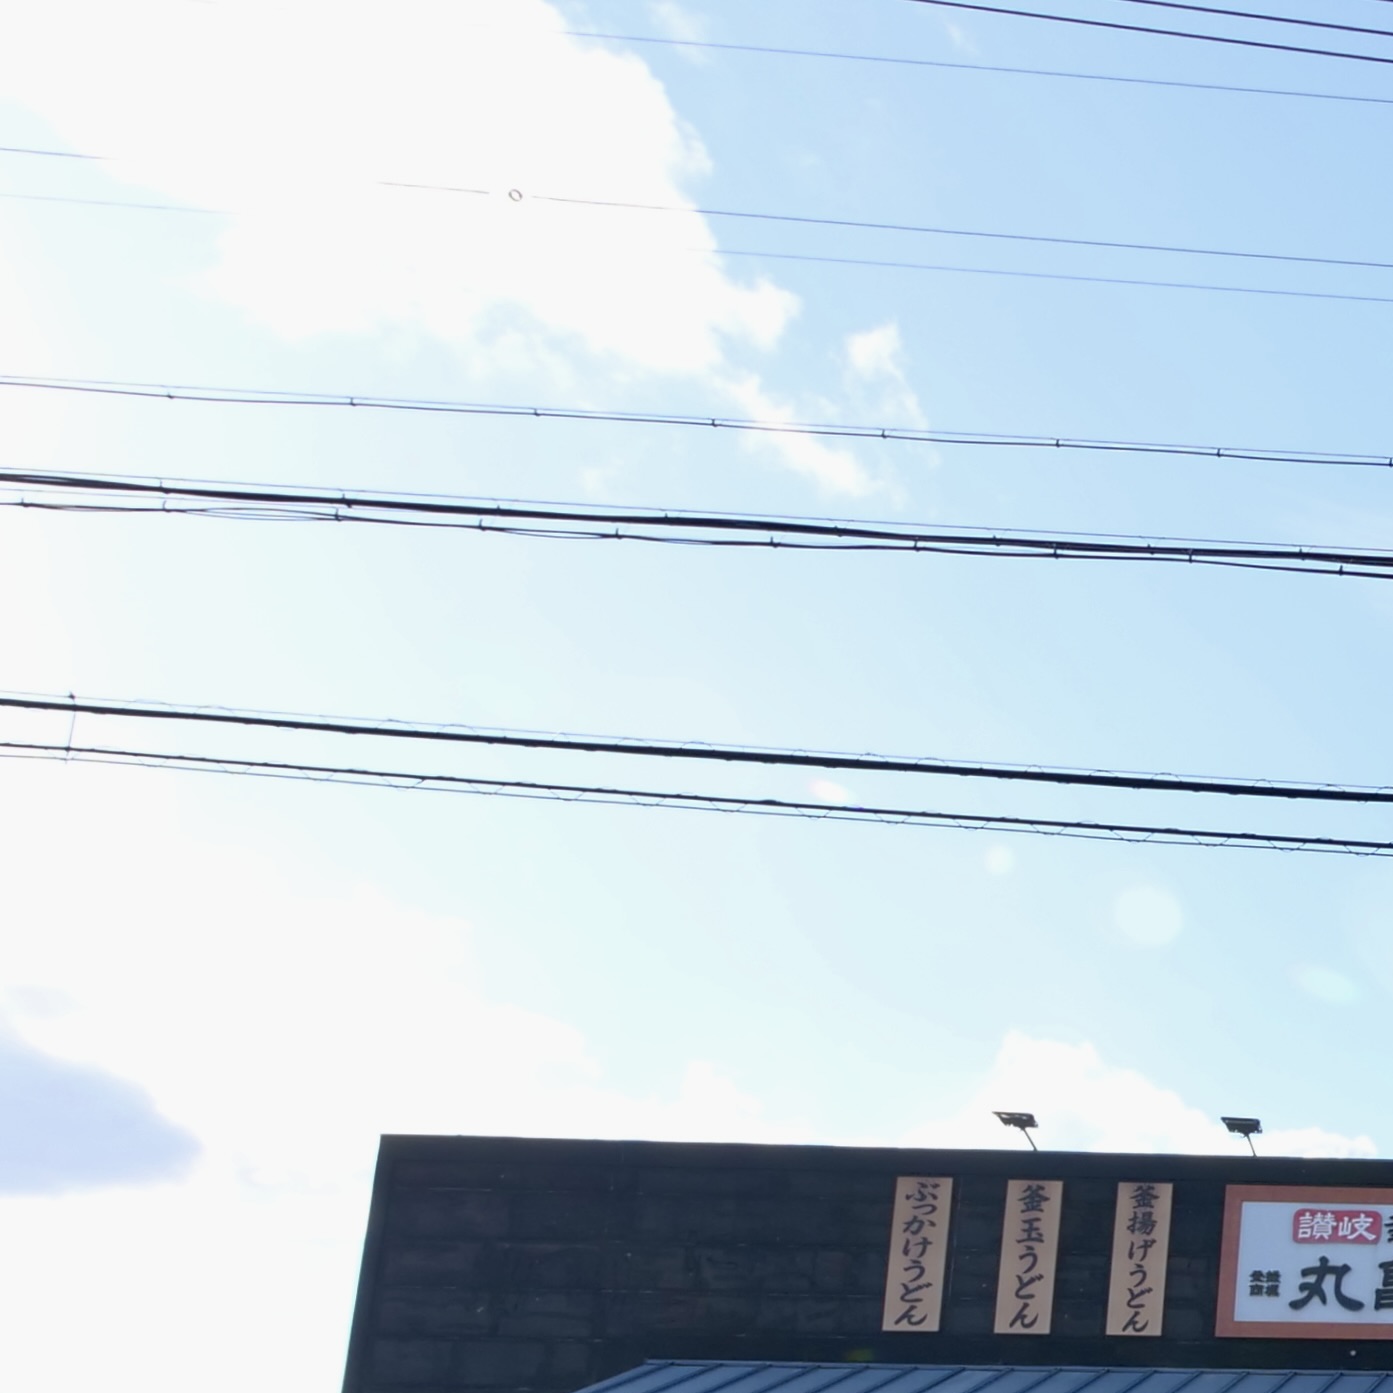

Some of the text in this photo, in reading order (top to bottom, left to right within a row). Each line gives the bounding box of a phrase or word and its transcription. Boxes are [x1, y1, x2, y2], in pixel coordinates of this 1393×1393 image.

[894, 1181, 941, 1326] ぶっかけうどん
[1009, 1184, 1051, 1329] 釜玉うどん
[1121, 1185, 1160, 1333] 釜揚げうどん
[1297, 1211, 1377, 1241] 讃岐
